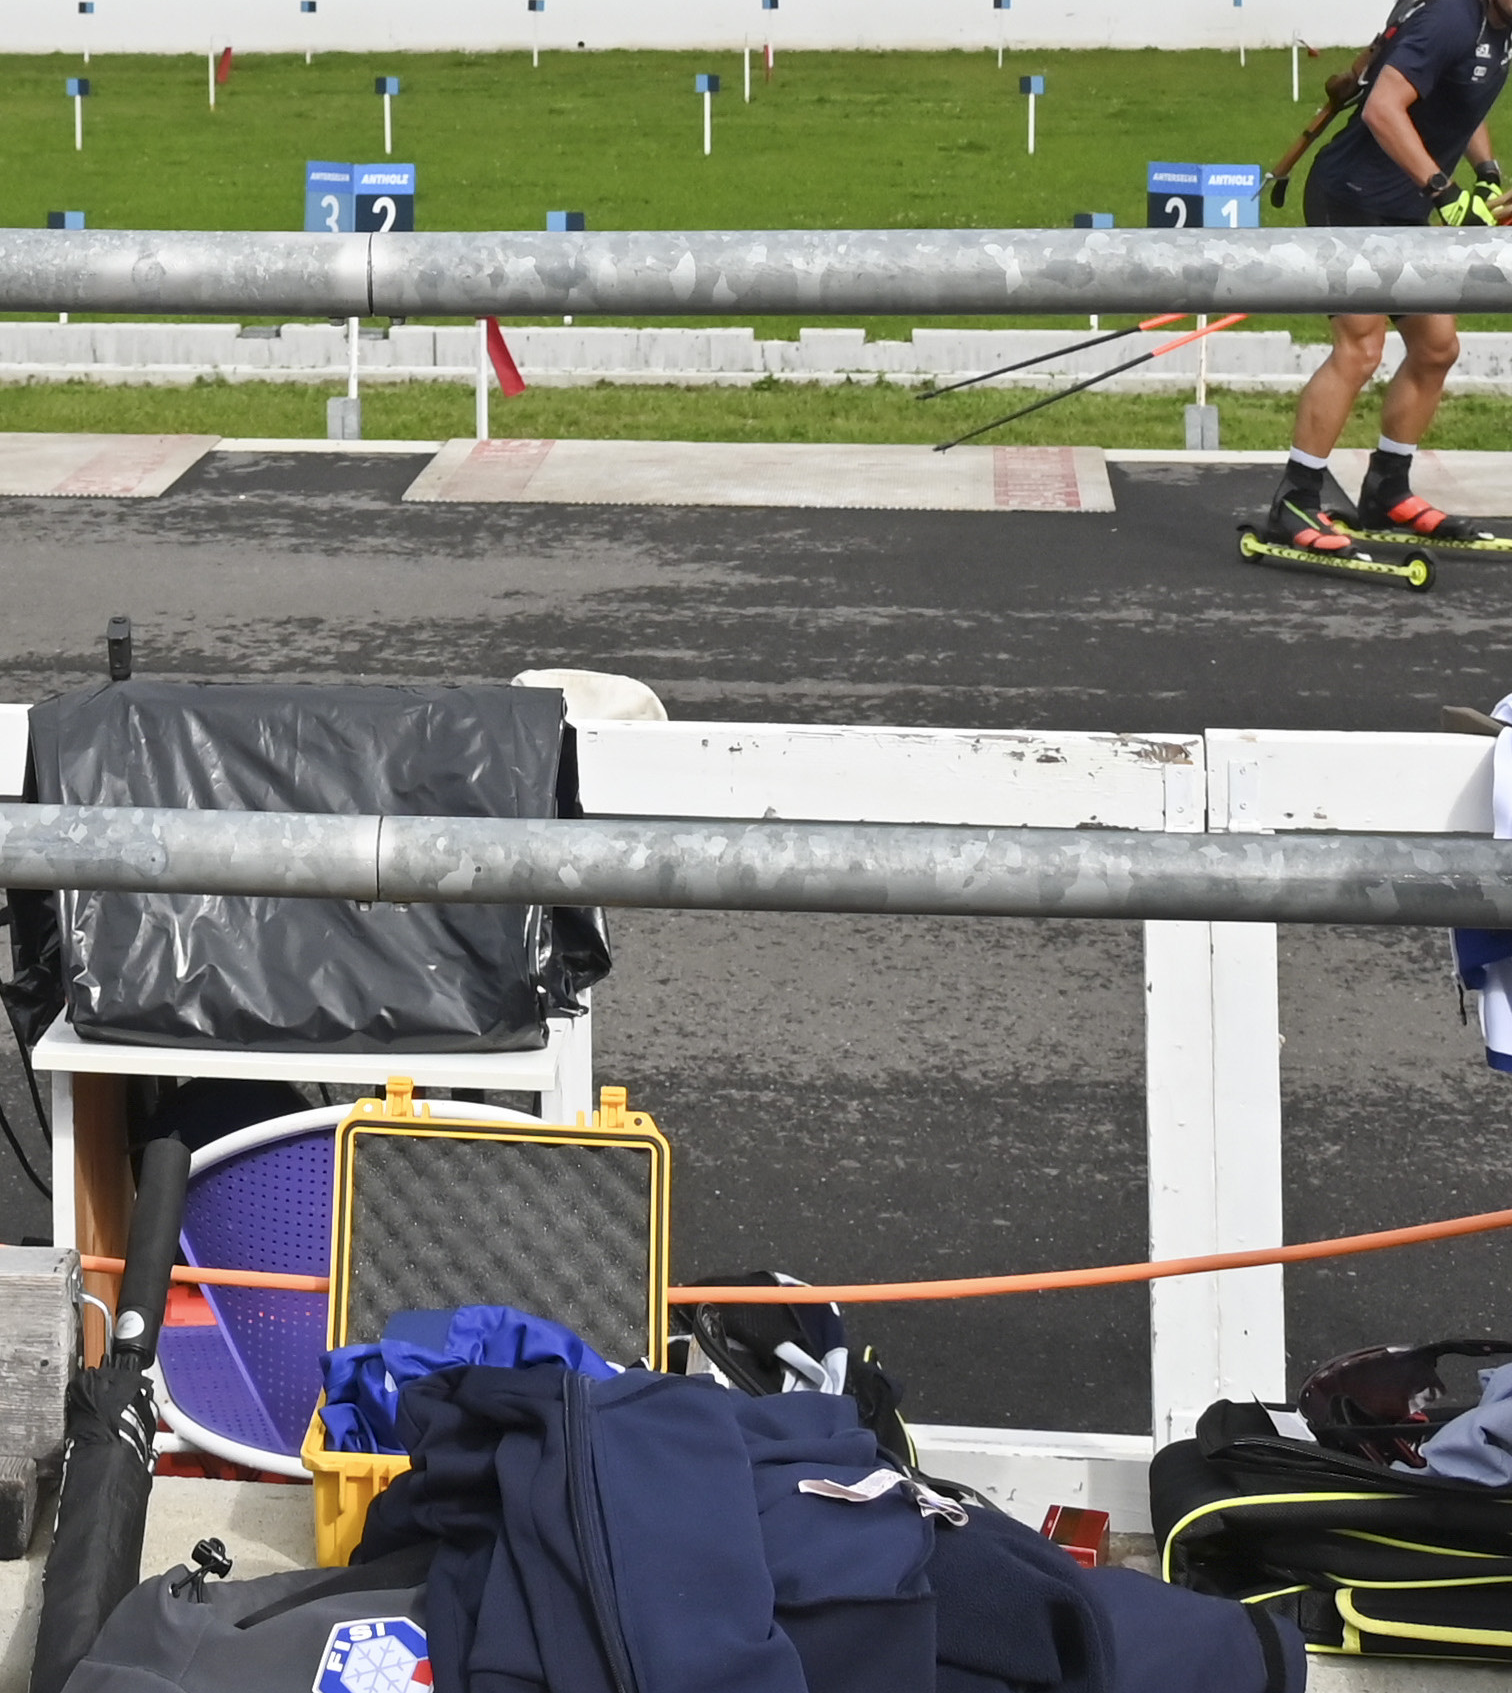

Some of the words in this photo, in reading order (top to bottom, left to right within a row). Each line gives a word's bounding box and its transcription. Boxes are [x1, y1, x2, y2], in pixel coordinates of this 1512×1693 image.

[361, 173, 409, 185] ANTHOLZ
[1208, 174, 1255, 186] ANTHOLZ
[326, 1622, 386, 1673] FISI
